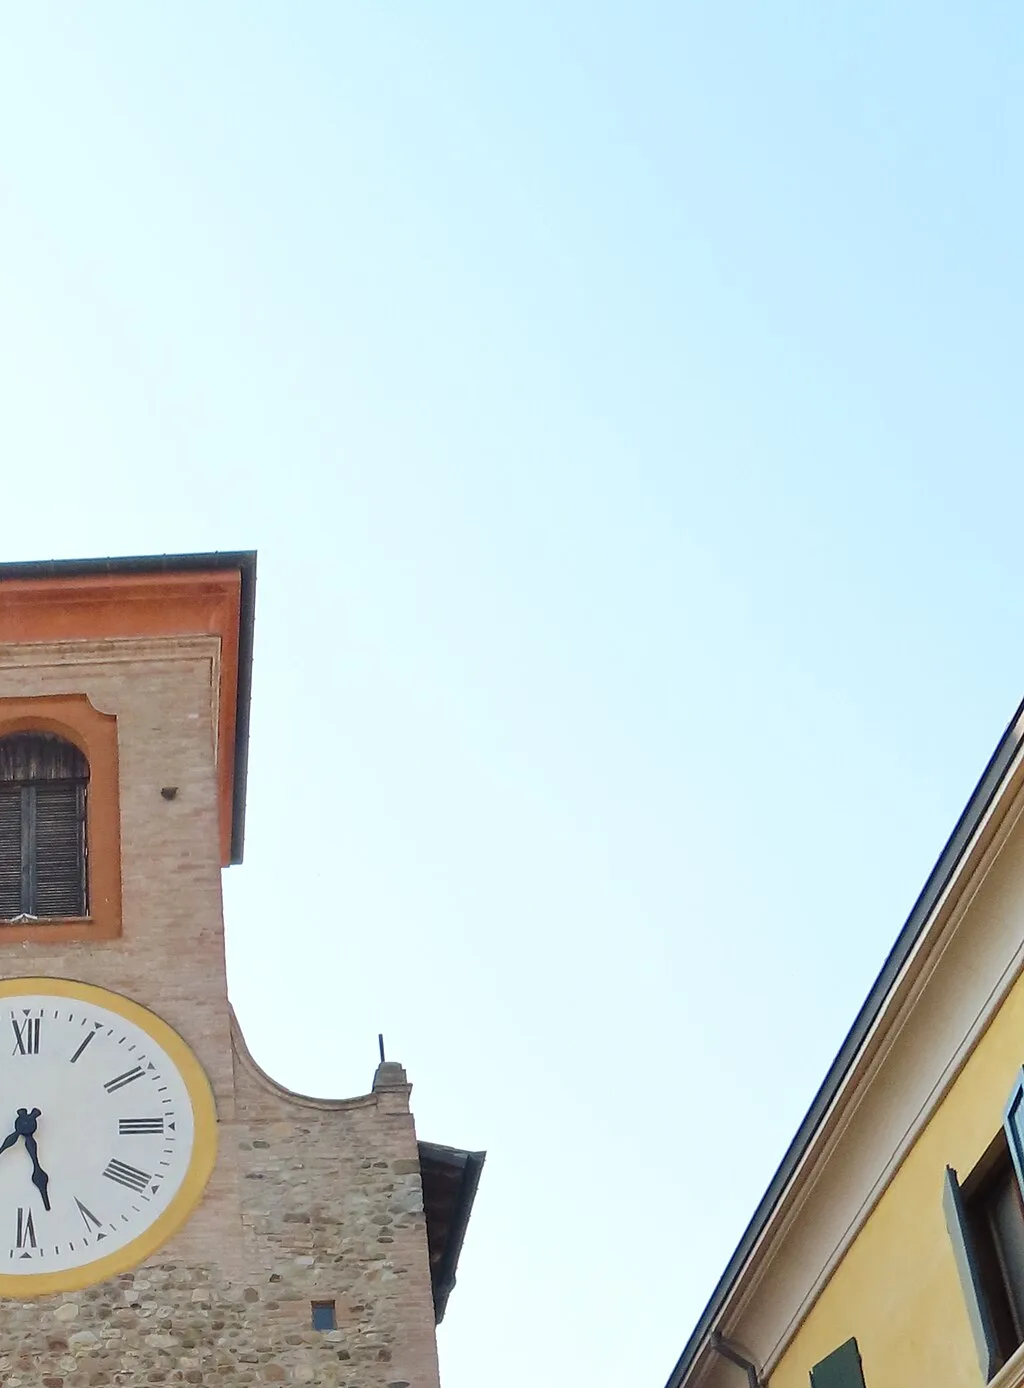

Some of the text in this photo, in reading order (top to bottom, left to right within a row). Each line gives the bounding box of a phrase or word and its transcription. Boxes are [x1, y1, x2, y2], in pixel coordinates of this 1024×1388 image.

[12, 1018, 40, 1056] XII
[70, 1031, 96, 1063] I
[103, 1065, 146, 1094] II
[119, 1118, 164, 1135] III
[102, 1158, 152, 1194] IIII
[16, 1207, 37, 1248] VI
[73, 1195, 103, 1233] V
